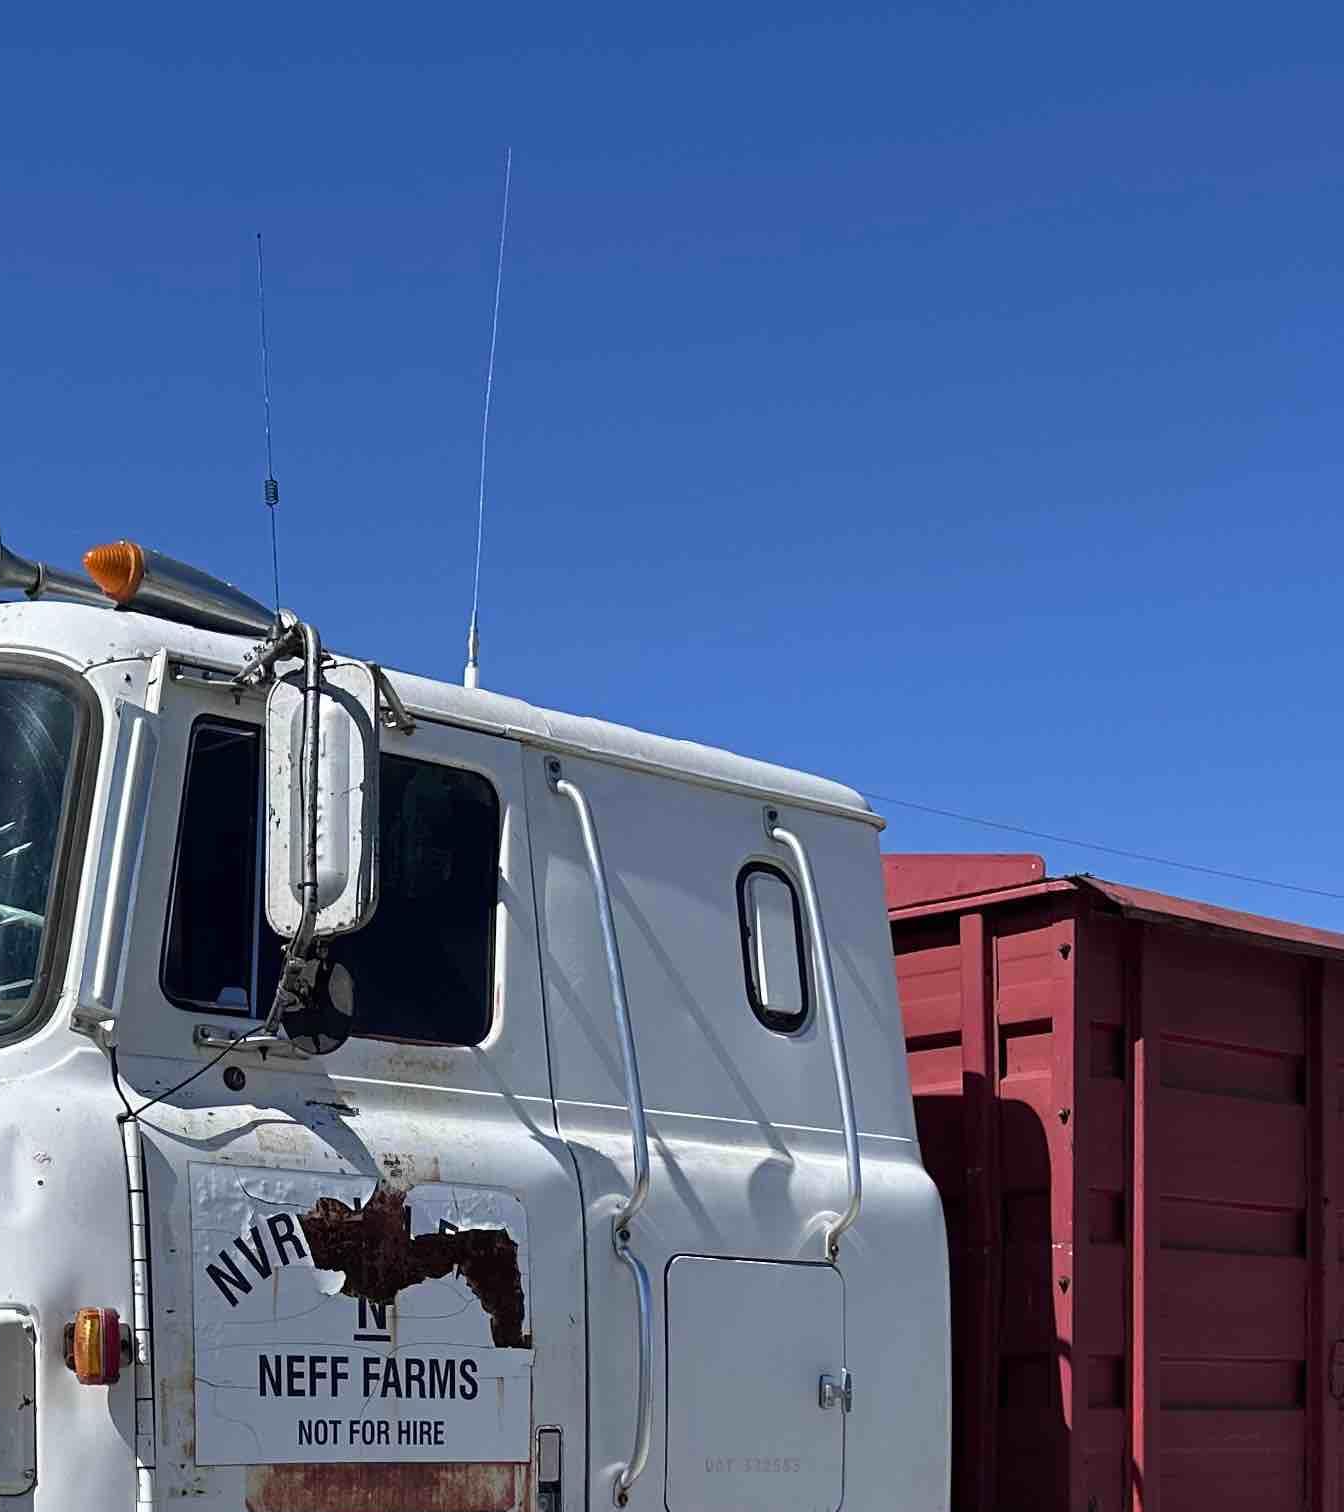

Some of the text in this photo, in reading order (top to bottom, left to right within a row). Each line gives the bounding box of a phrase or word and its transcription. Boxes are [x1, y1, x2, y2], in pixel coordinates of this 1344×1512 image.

[258, 1354, 480, 1401] NEFF FARMS
[297, 1419, 446, 1446] NOT FOR HIRE
